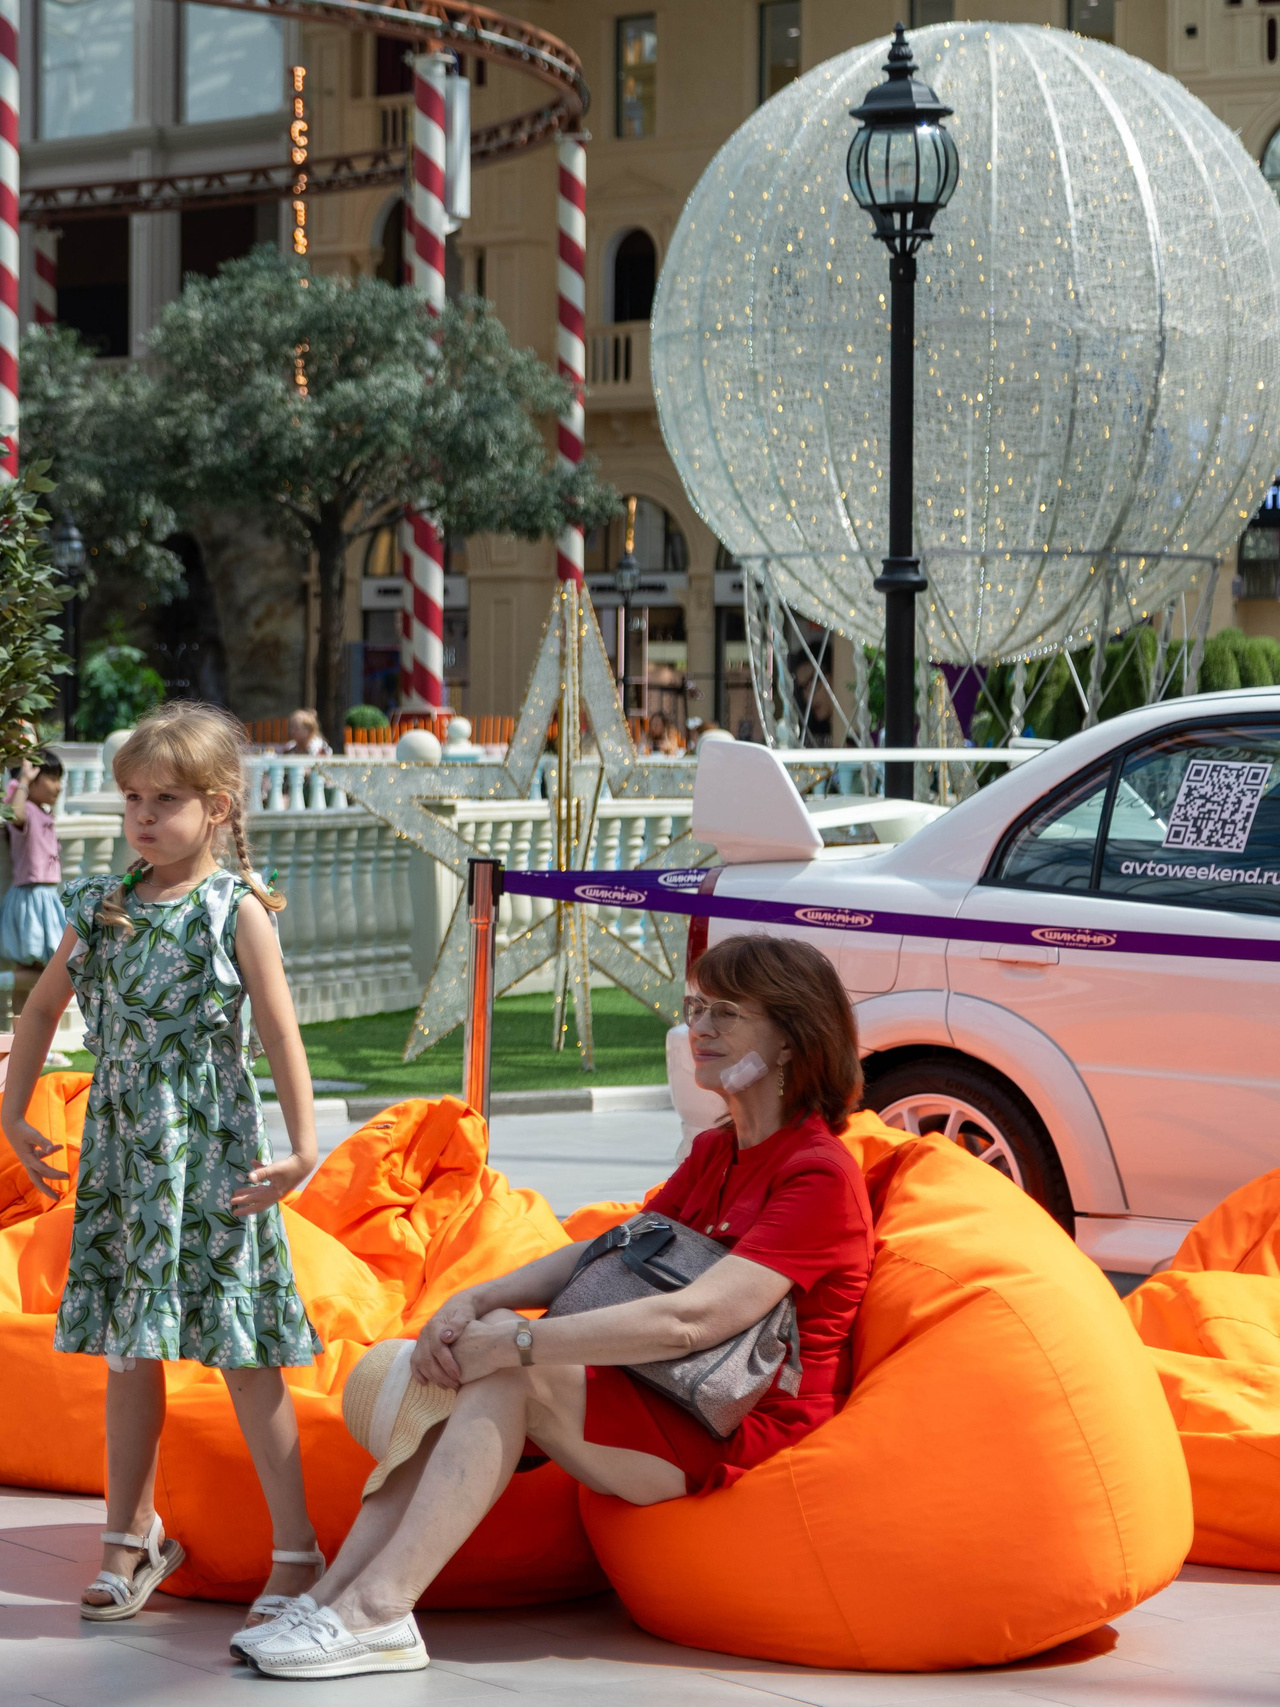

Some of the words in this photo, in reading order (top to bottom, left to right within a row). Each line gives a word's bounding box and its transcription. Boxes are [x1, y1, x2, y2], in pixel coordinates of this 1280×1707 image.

[585, 888, 639, 902] ШИКАНА
[806, 911, 865, 925] ШИКАНА
[1044, 931, 1108, 944] ШИКАНА
